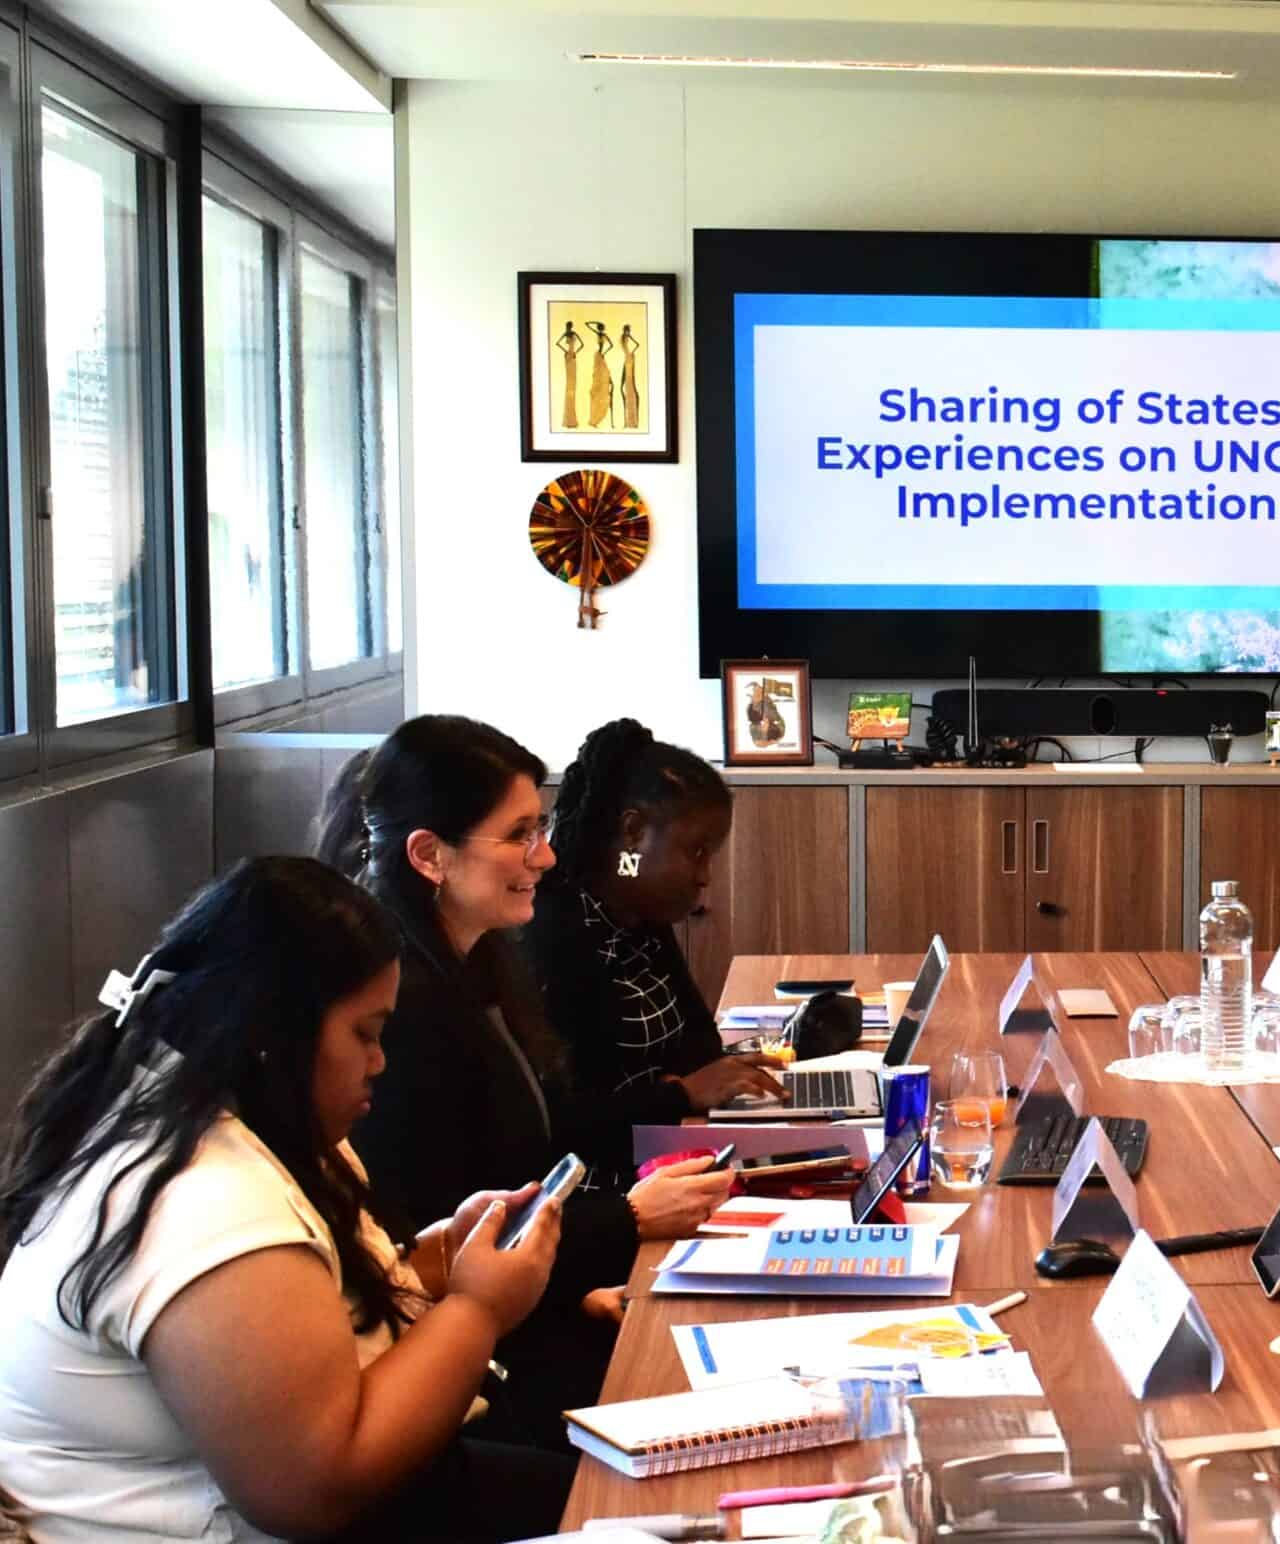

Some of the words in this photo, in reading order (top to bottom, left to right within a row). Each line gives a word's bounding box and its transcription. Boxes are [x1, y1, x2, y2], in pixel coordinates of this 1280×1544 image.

[878, 386, 1061, 432] Sharing
[1077, 390, 1125, 424] of
[816, 434, 1105, 478] Experiences
[1119, 446, 1176, 473] on
[898, 483, 1276, 526] Implementation
